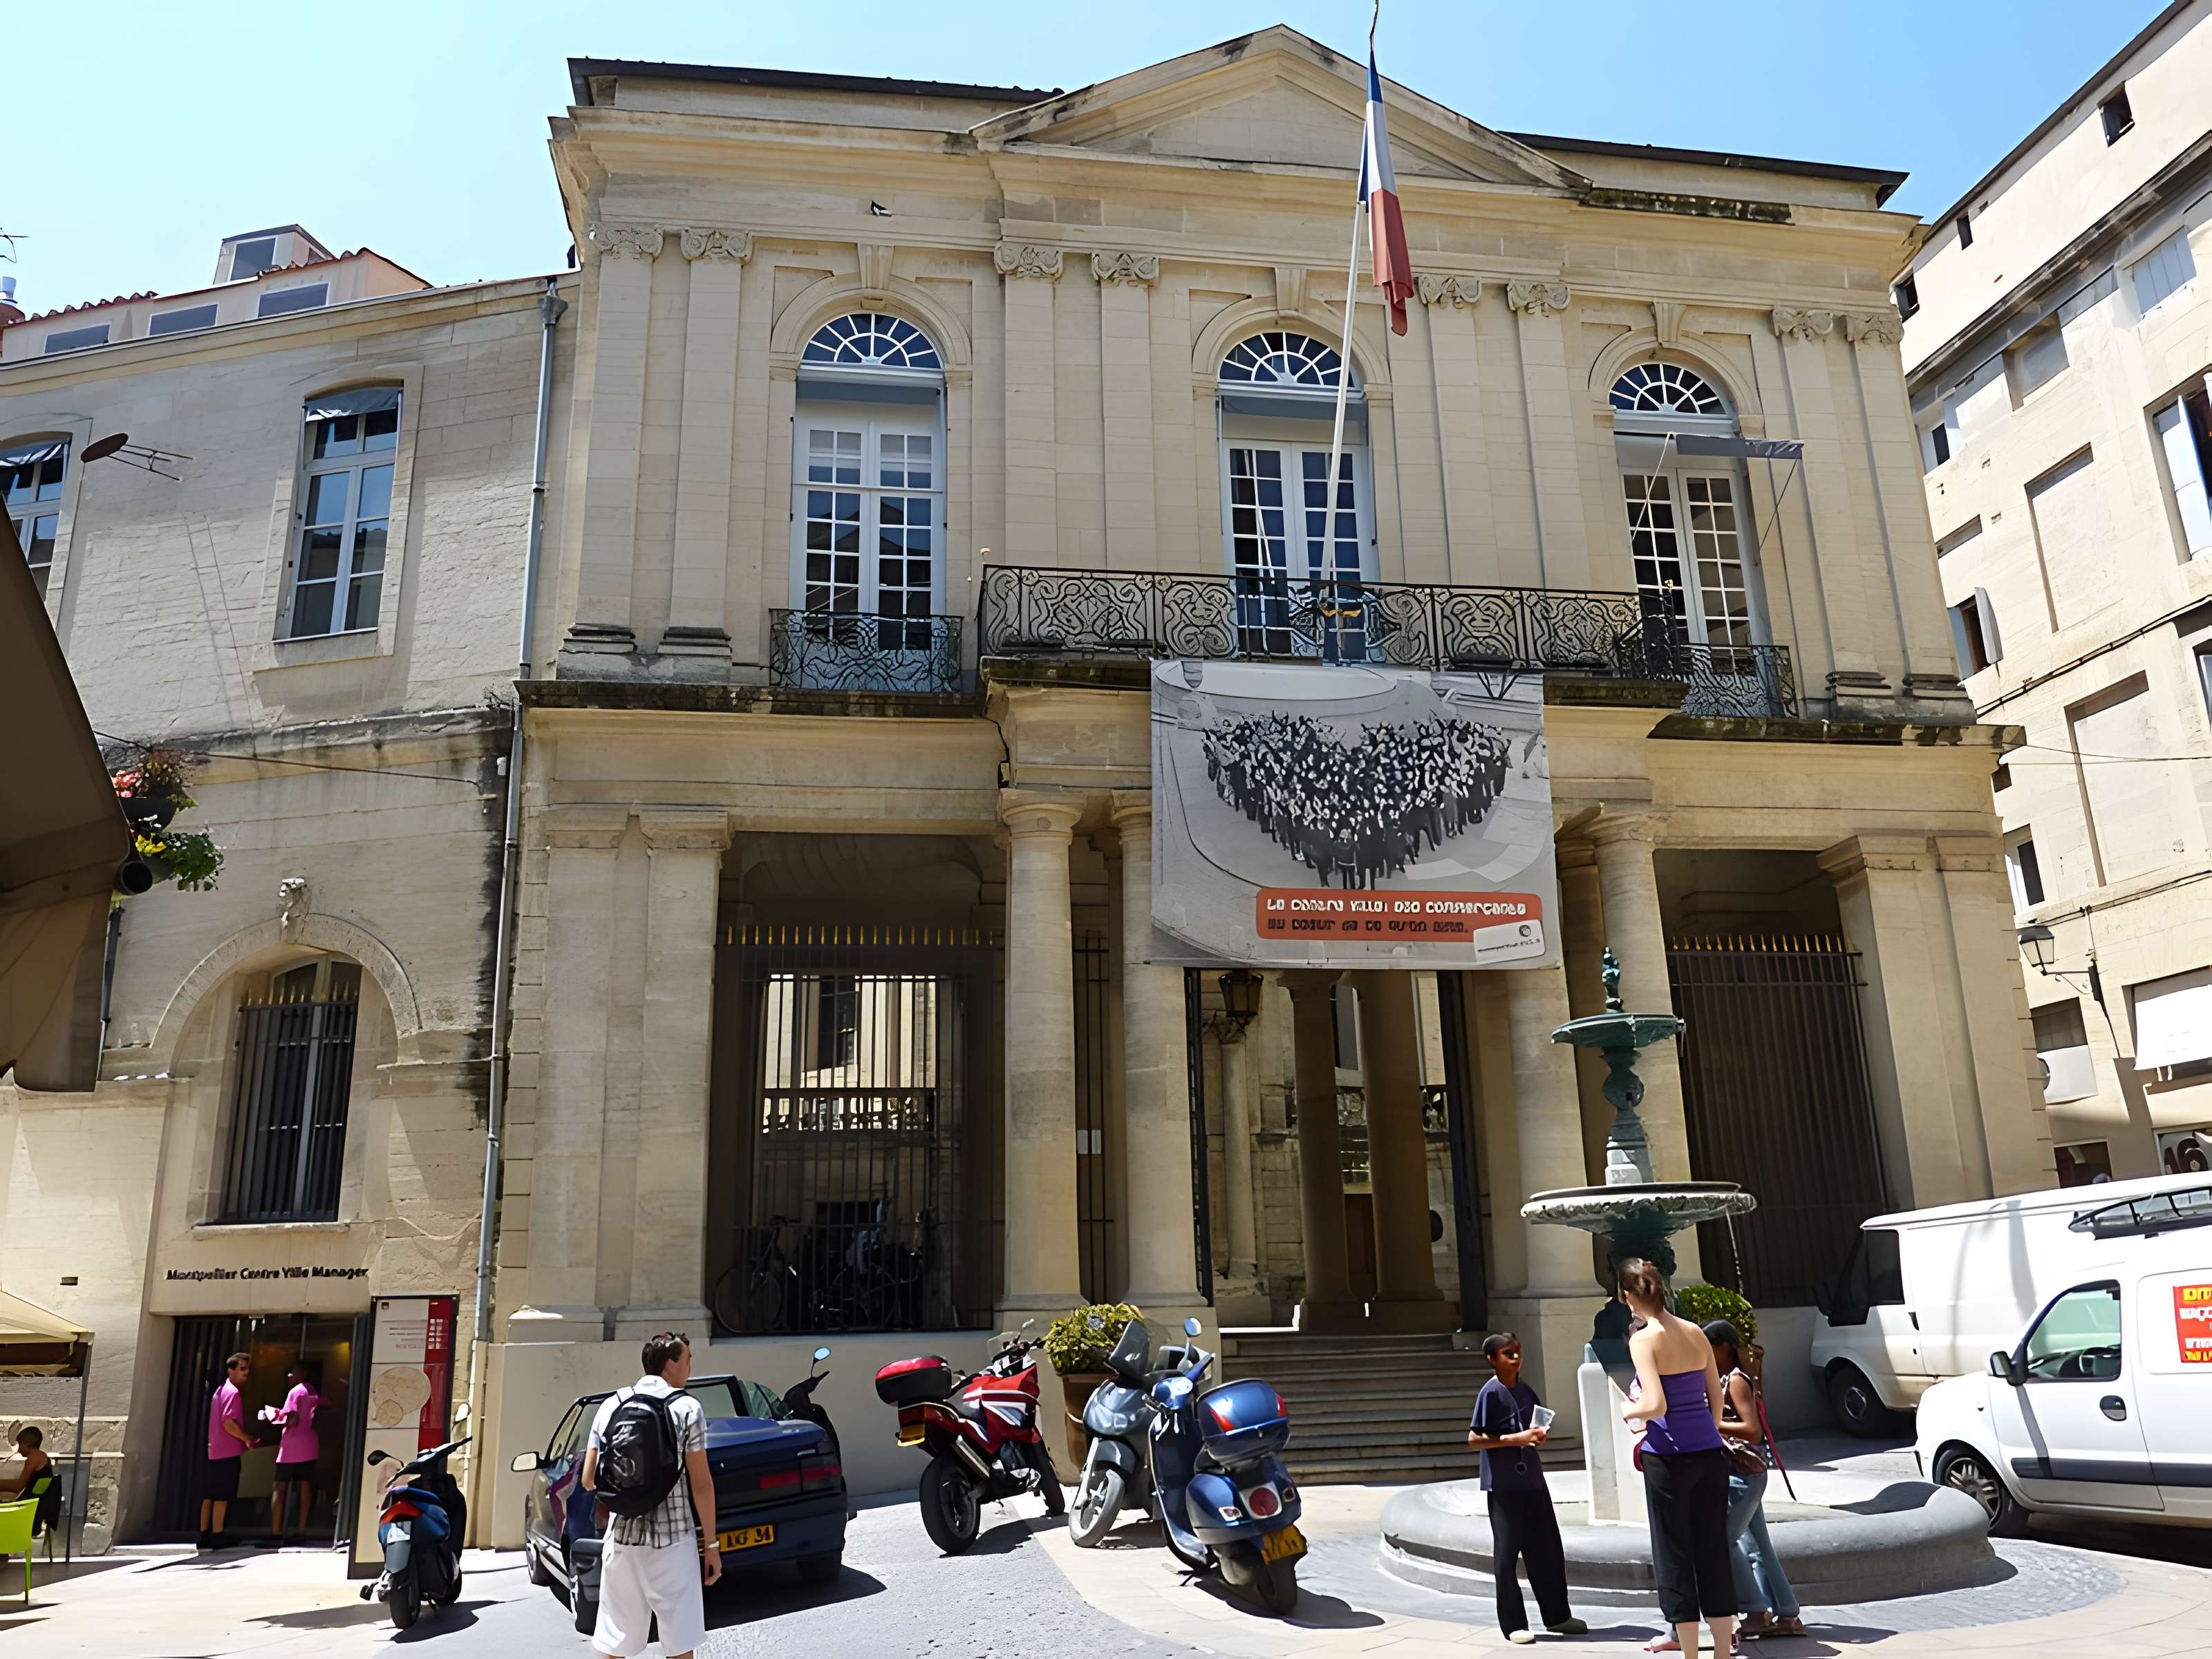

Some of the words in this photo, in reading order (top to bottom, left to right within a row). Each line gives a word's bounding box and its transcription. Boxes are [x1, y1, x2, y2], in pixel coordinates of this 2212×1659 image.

[241, 1268, 280, 1280] Centre
[282, 1266, 309, 1278] Ville
[312, 1266, 368, 1280] Manager
